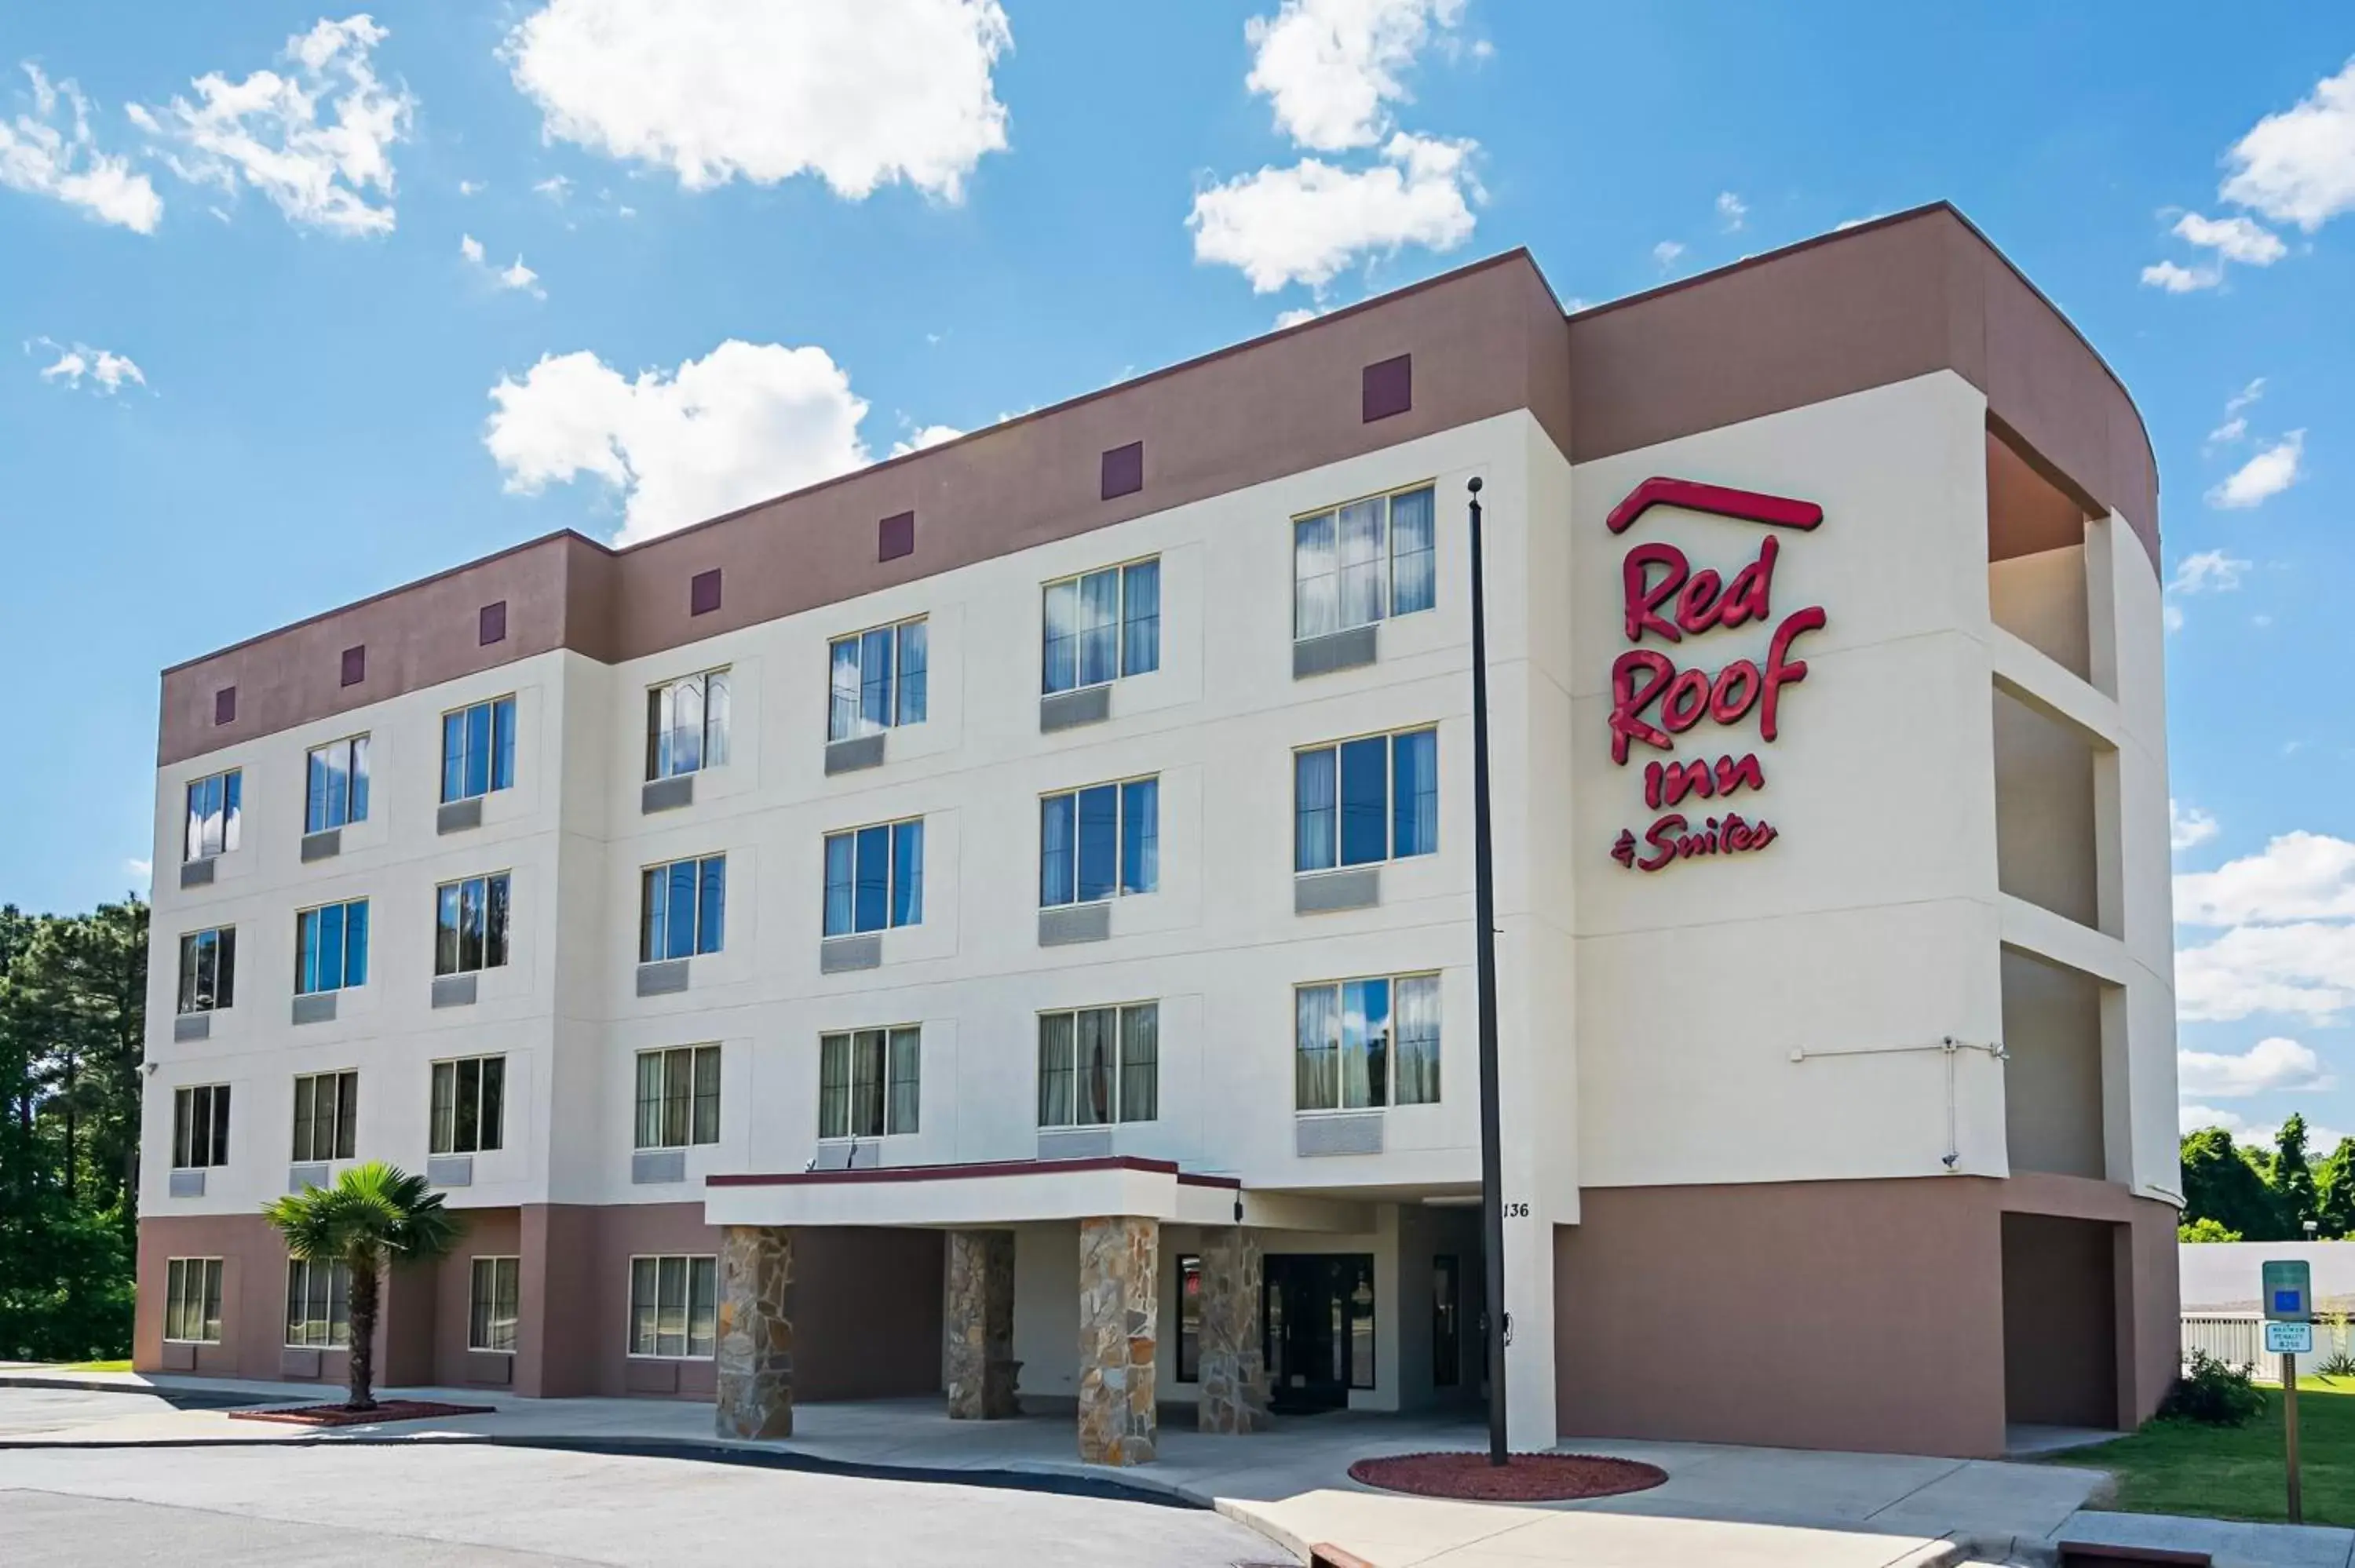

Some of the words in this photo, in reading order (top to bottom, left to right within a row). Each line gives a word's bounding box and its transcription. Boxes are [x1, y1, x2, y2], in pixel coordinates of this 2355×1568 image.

[1623, 534, 1780, 643] Red
[1608, 606, 1827, 766] Roof
[1638, 812, 1778, 872] Suites
[1503, 1203, 1529, 1218] 136
